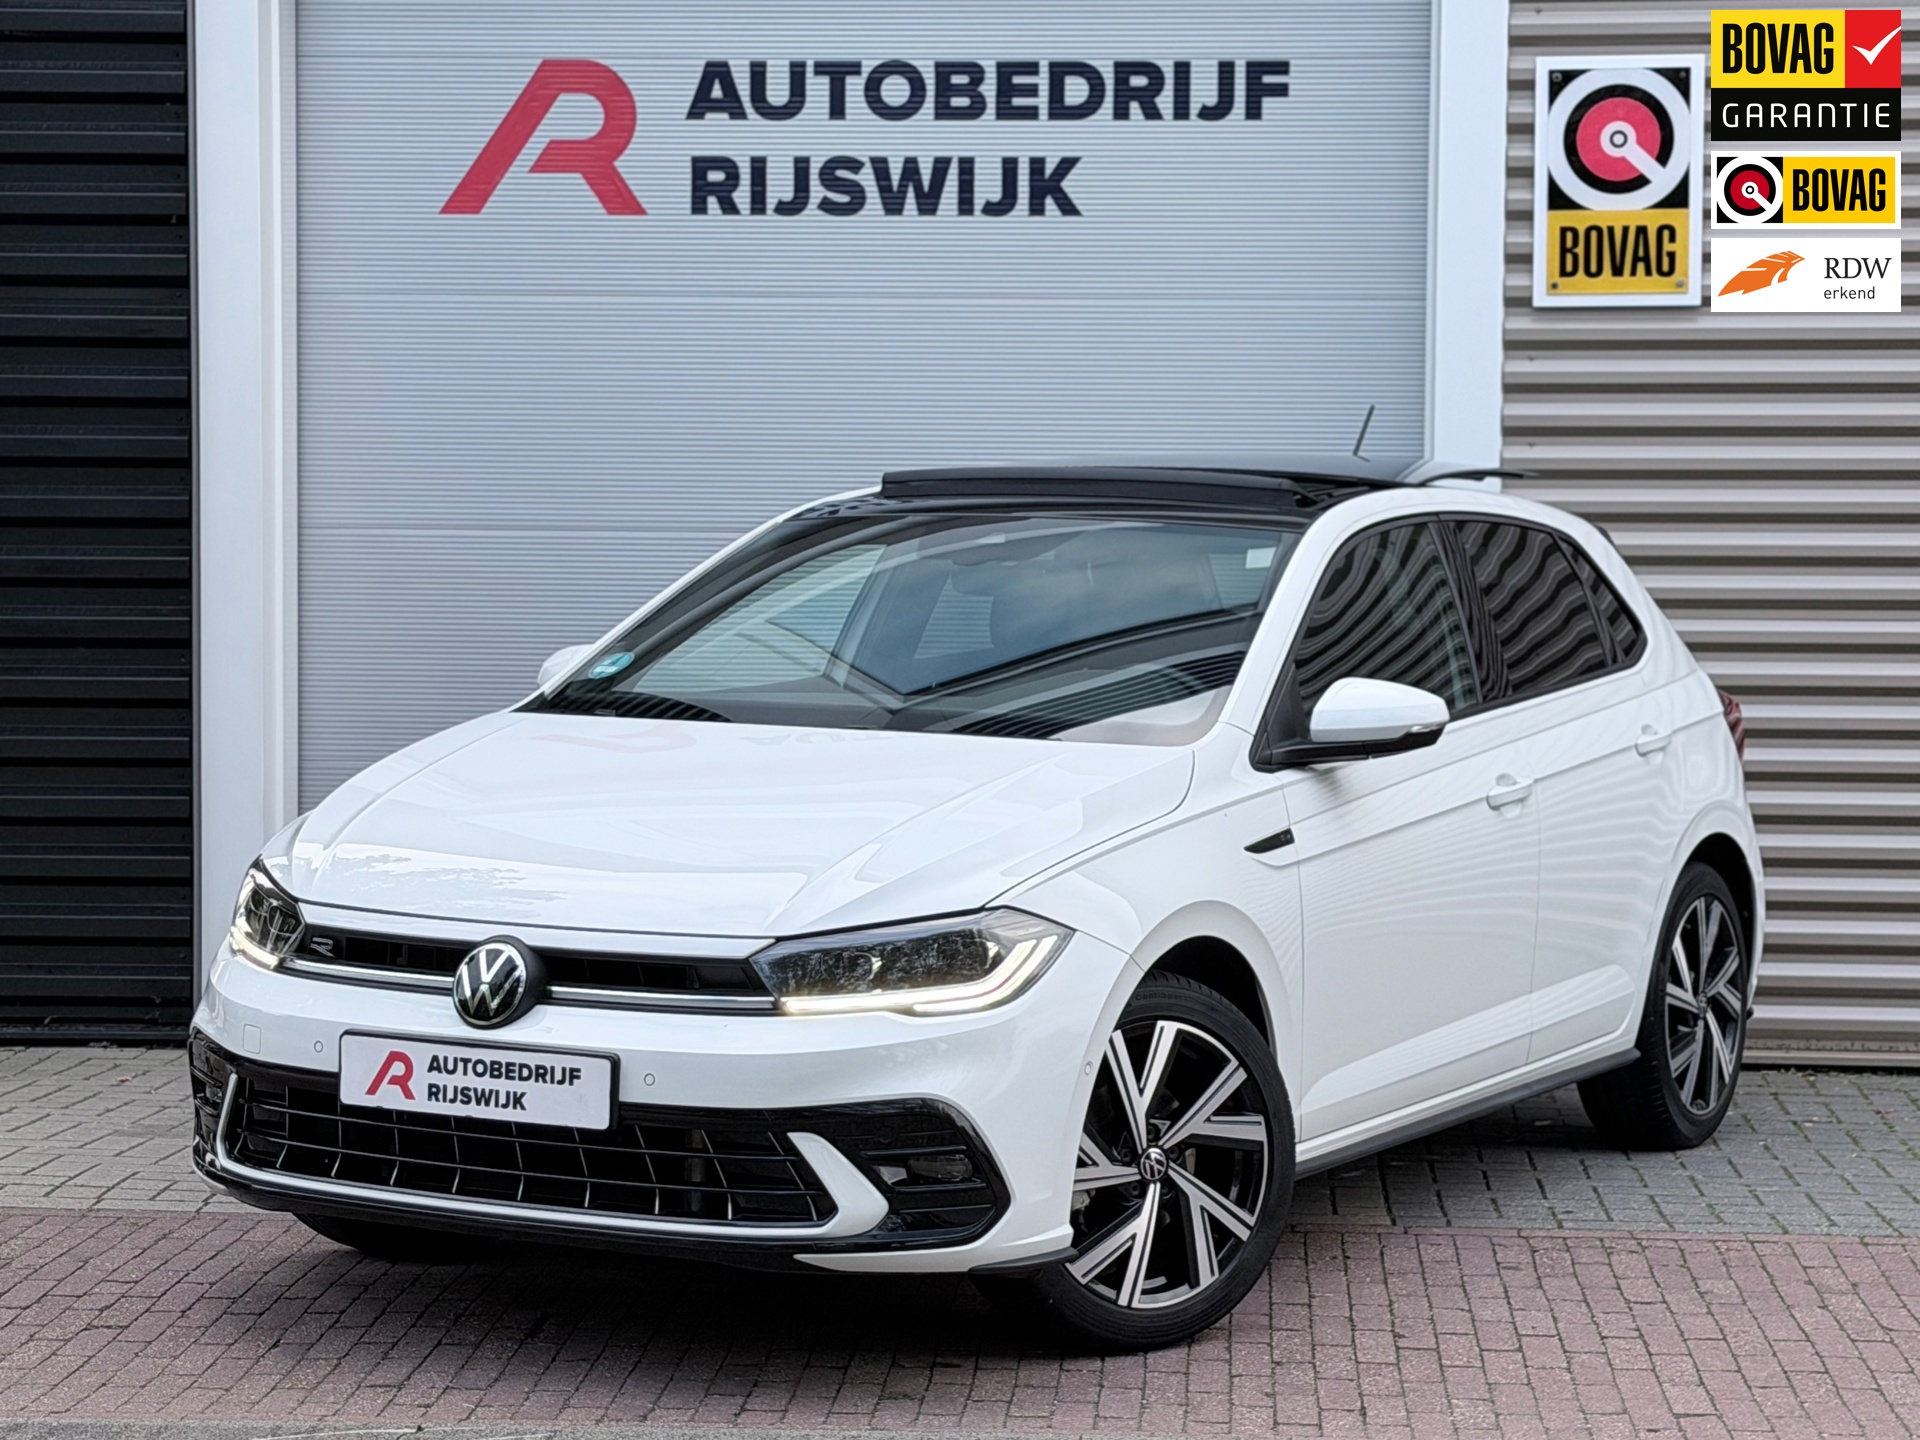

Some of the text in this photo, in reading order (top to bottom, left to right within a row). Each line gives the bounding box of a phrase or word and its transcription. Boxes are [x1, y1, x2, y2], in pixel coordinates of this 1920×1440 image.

[686, 59, 1290, 121] AUTOBEDRIJF
[691, 155, 1083, 217] RIJSWIJK
[1558, 223, 1677, 279] BOVAG
[427, 1054, 582, 1087] AUTOBEDRIJF
[427, 1083, 527, 1111] RIJSWIJK
